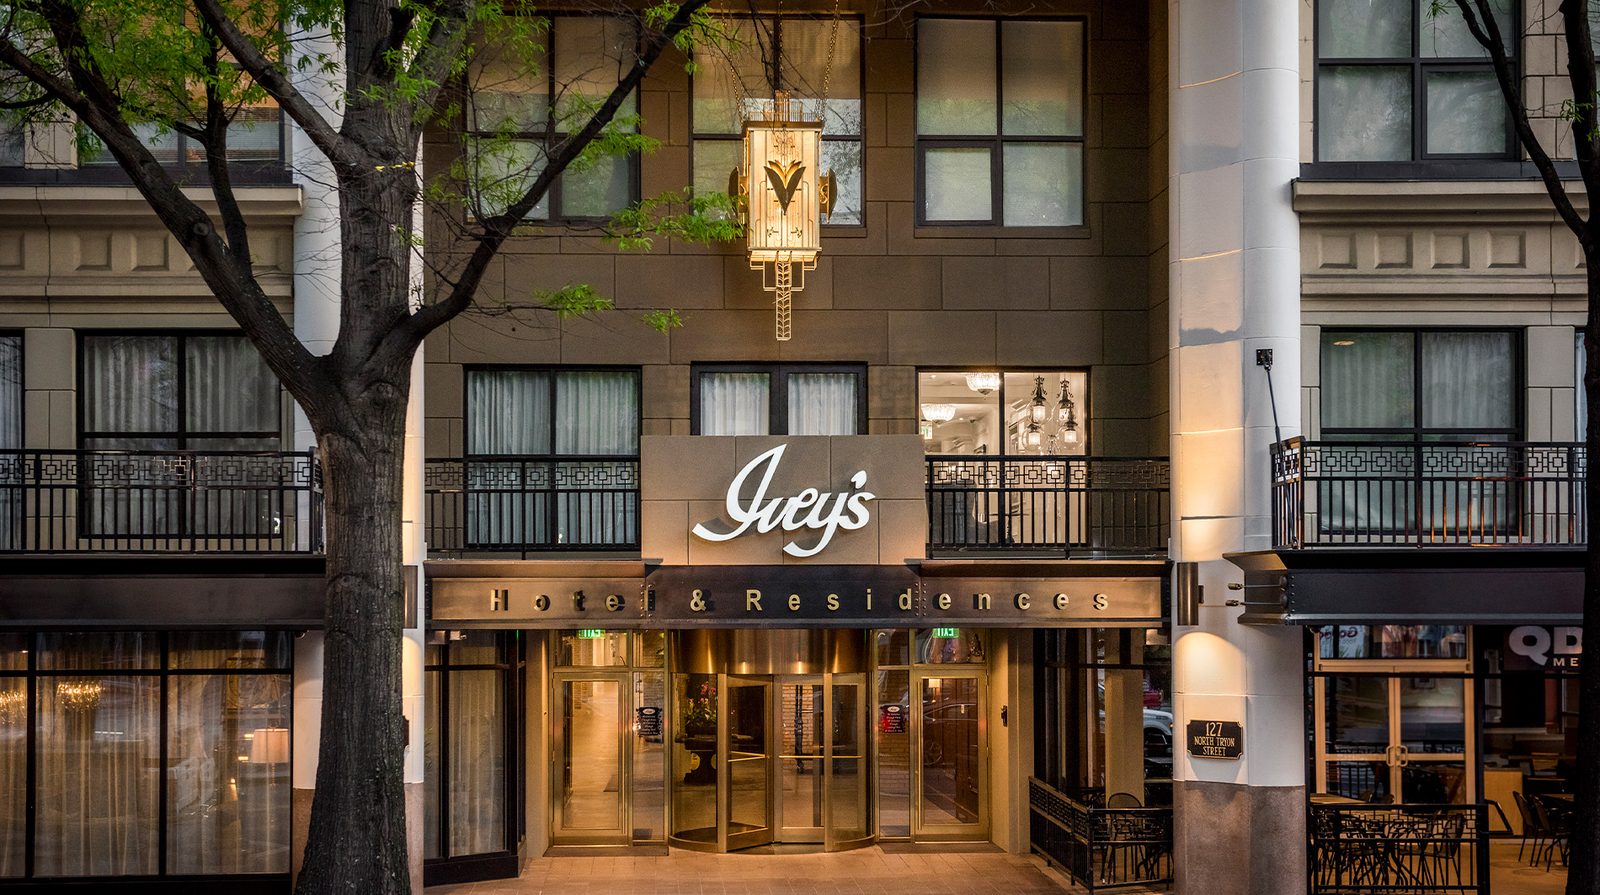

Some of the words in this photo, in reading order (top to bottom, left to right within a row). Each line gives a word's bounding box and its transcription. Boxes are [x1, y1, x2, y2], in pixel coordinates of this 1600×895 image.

[692, 444, 876, 557] Ivey's
[490, 589, 649, 611] Hotel
[690, 589, 707, 611] &
[746, 589, 1109, 611] Residences
[1206, 722, 1223, 737] 127
[1194, 736, 1214, 746] NORTH
[1215, 737, 1235, 747] TRYON
[1202, 746, 1226, 757] STREET
